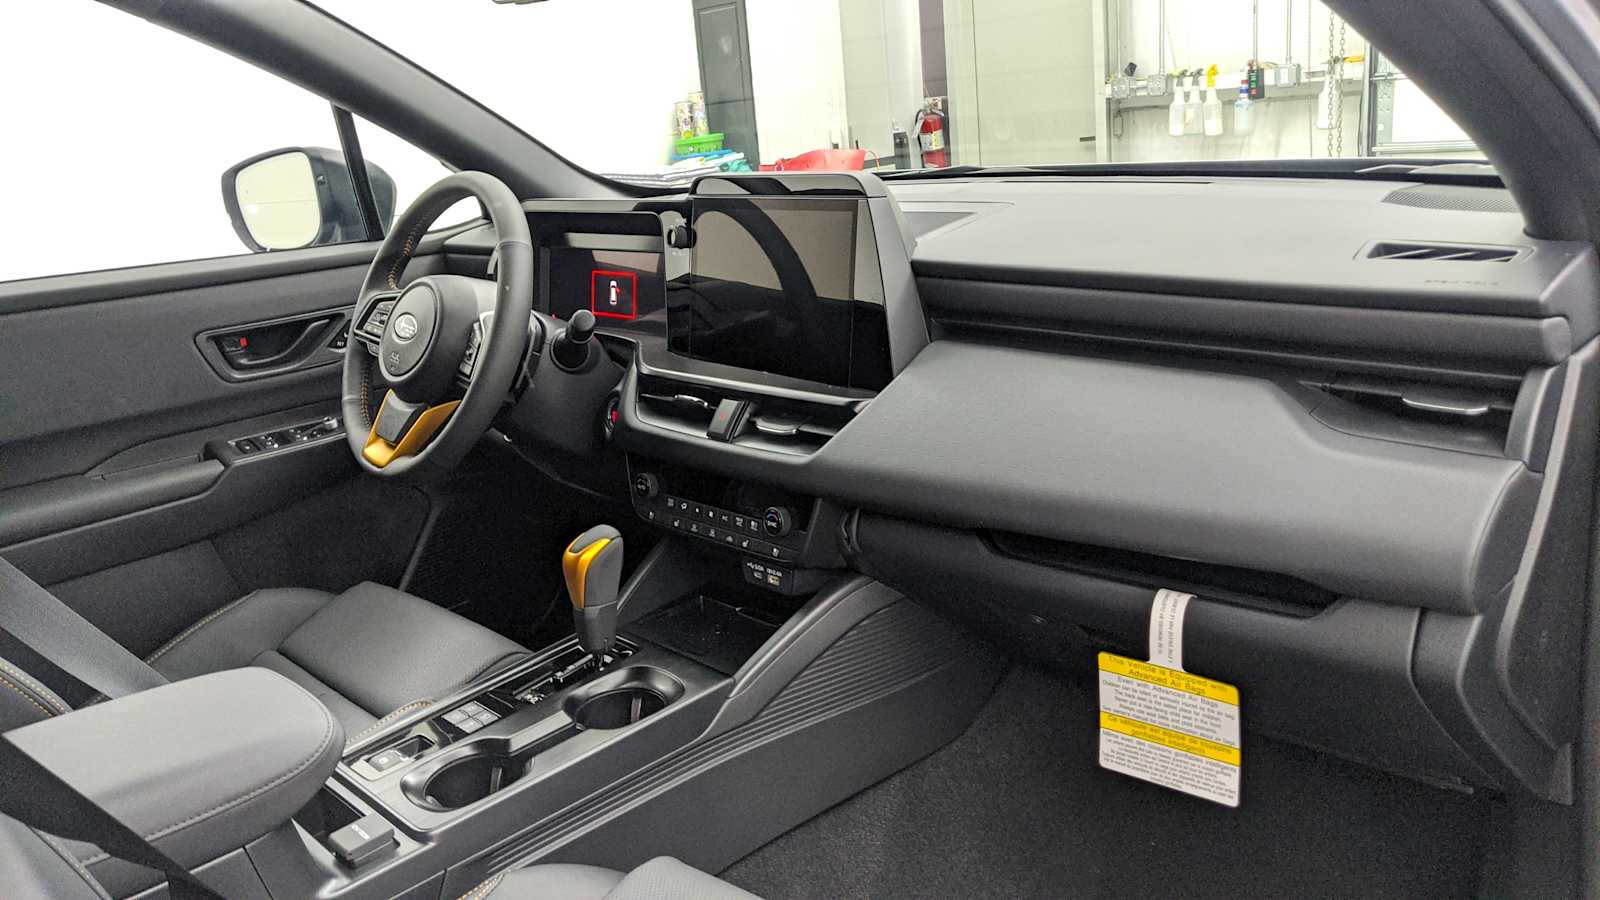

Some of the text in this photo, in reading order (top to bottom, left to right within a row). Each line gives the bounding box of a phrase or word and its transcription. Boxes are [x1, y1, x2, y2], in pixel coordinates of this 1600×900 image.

[1108, 655, 1124, 665] This
[1127, 660, 1156, 674] Vehicle
[1159, 668, 1165, 676] is
[1168, 670, 1207, 688] Equipped
[1128, 668, 1205, 696] Advanced Air Bags
[1151, 684, 1186, 699] Advanced
[1200, 697, 1218, 709] Bags
